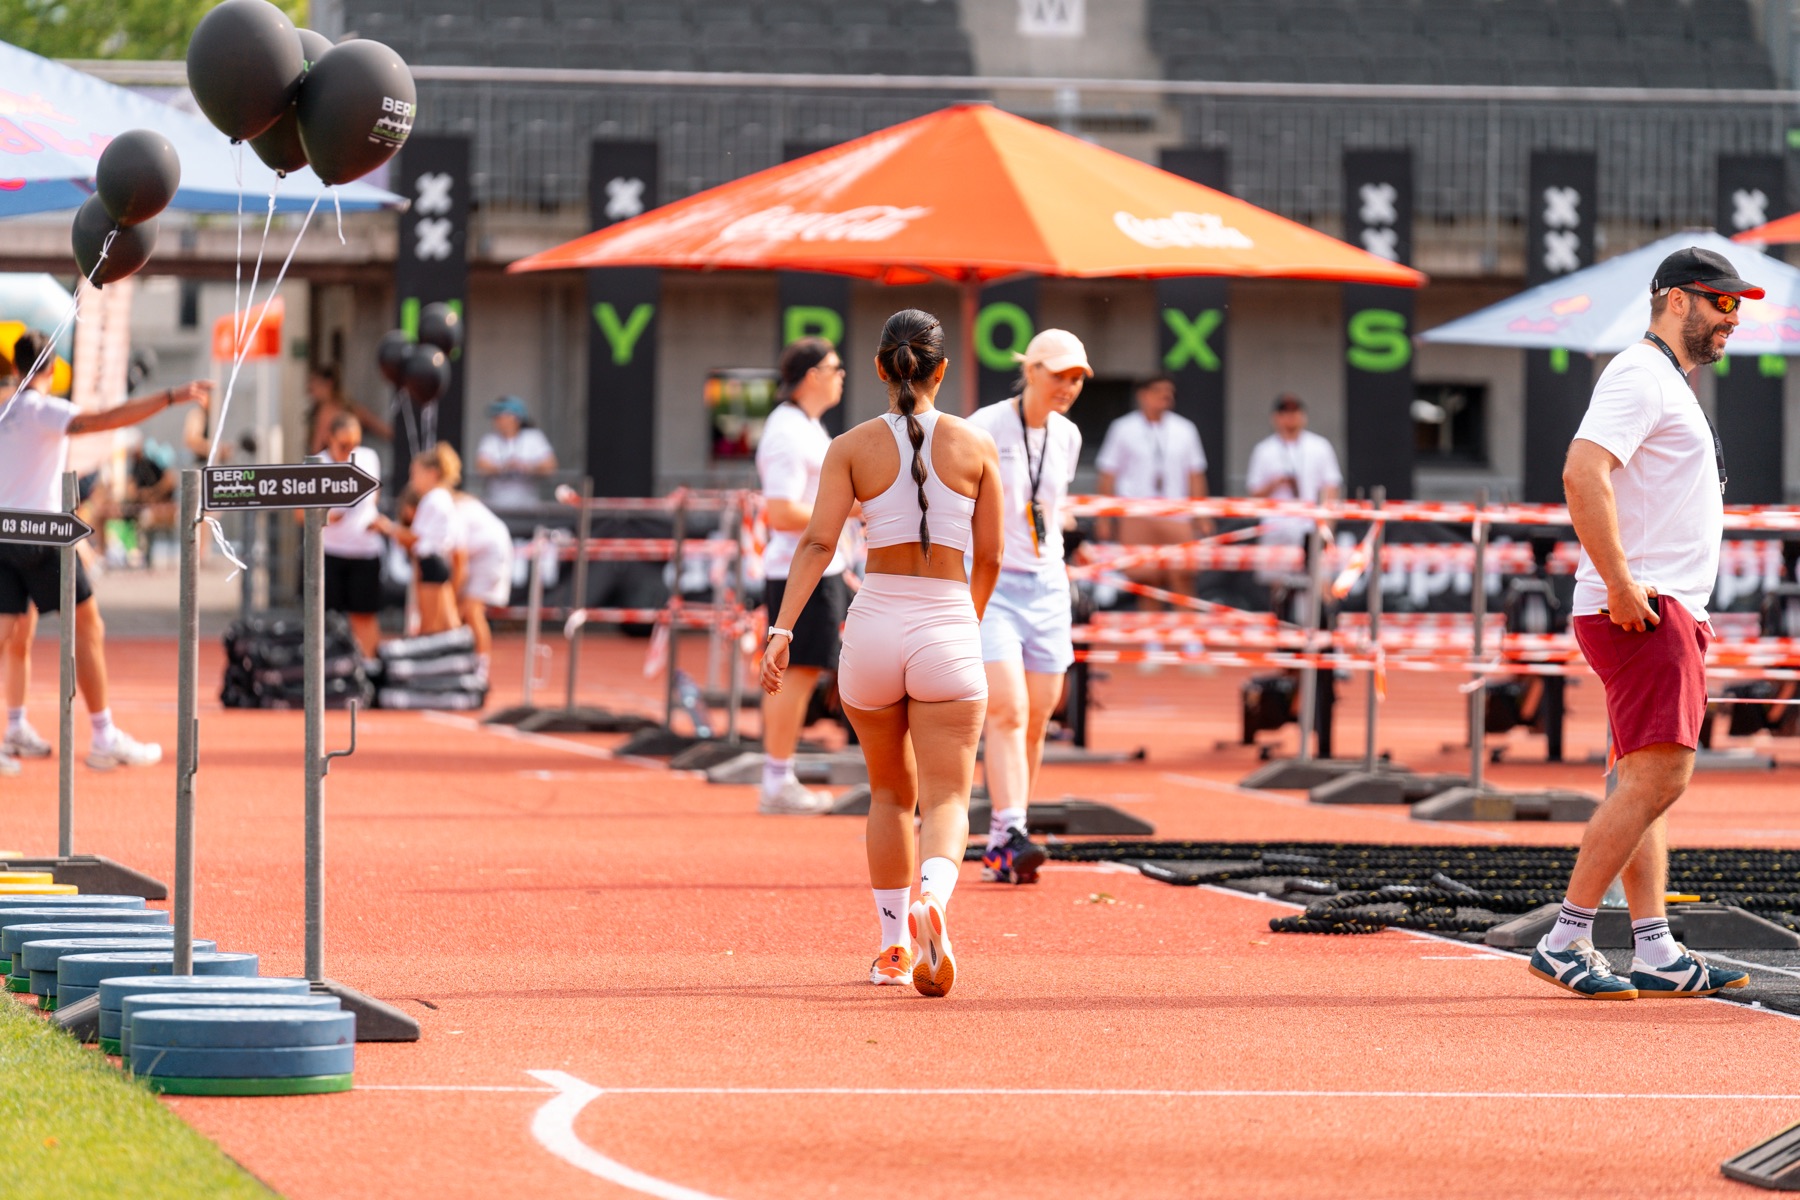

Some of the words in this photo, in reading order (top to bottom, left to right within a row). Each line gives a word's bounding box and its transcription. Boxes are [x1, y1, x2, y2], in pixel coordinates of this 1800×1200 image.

[213, 470, 255, 481] BERN
[258, 479, 277, 496] 02
[282, 478, 316, 495] Sled
[321, 477, 358, 494] Push
[2, 518, 16, 533] 03
[20, 519, 46, 535] Sled
[50, 521, 73, 537] Pull
